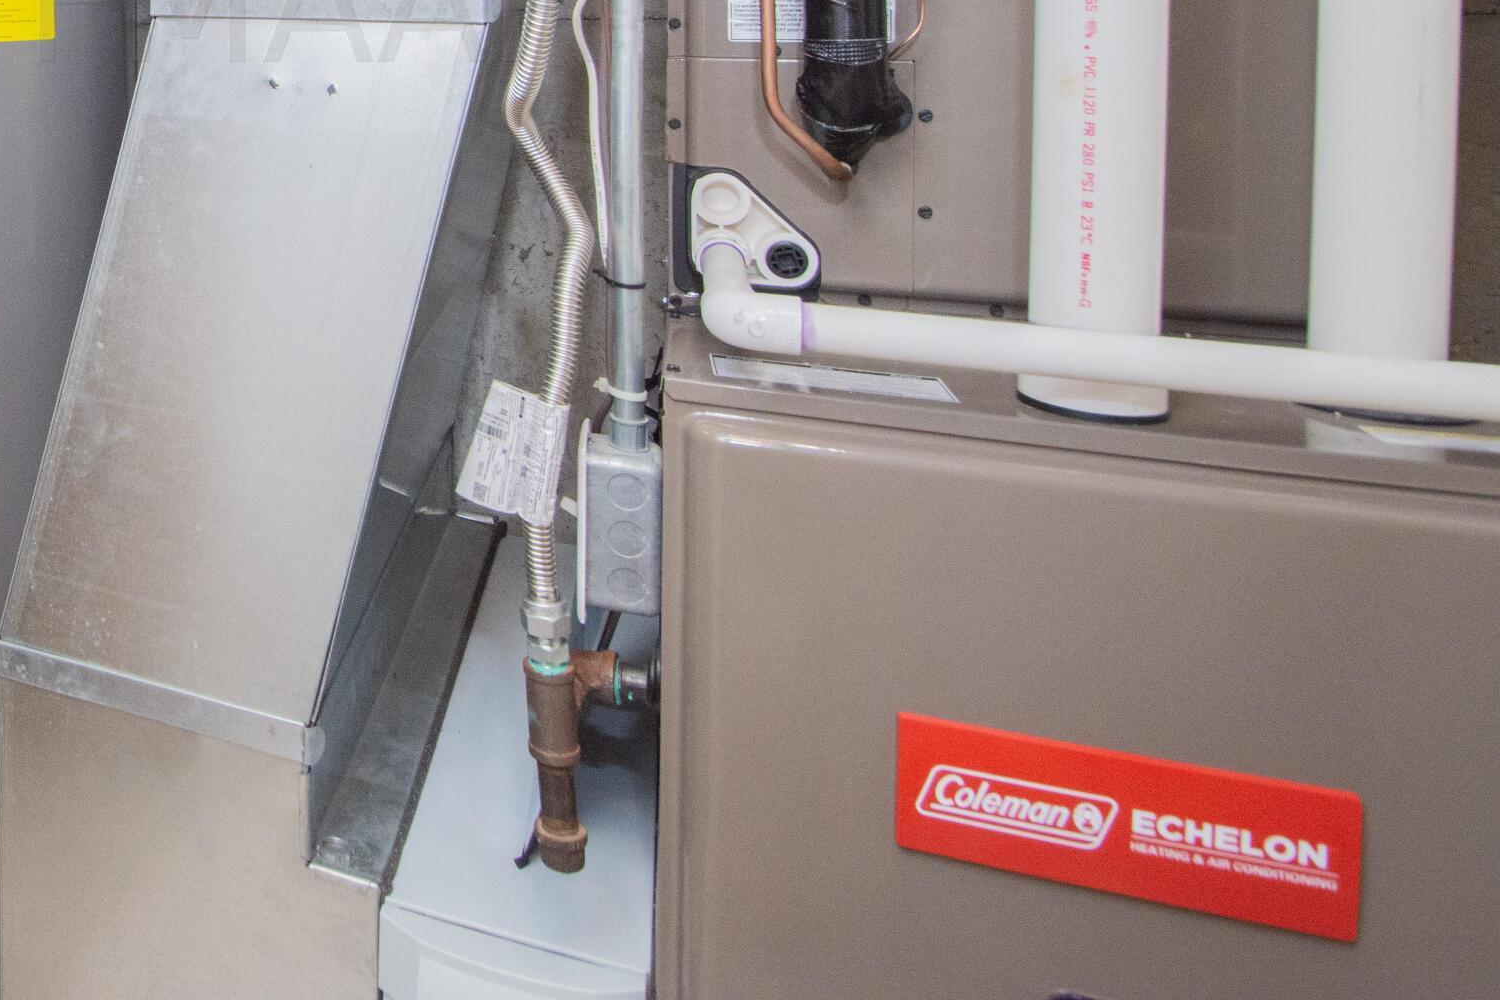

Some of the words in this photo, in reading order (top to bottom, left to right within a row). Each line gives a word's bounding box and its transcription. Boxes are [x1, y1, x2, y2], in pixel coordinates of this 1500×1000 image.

[1084, 55, 1098, 80] PVC
[1083, 87, 1097, 116] 1120
[1082, 121, 1096, 138] PR
[1081, 143, 1096, 167] 280
[1081, 171, 1095, 193] PSI
[934, 773, 1071, 829] Coleman
[1130, 809, 1329, 870] ECHELON
[1130, 841, 1192, 864] HEATING
[1193, 853, 1204, 866] &
[1207, 856, 1230, 871] AIR
[1233, 859, 1338, 892] CONDITIONING
